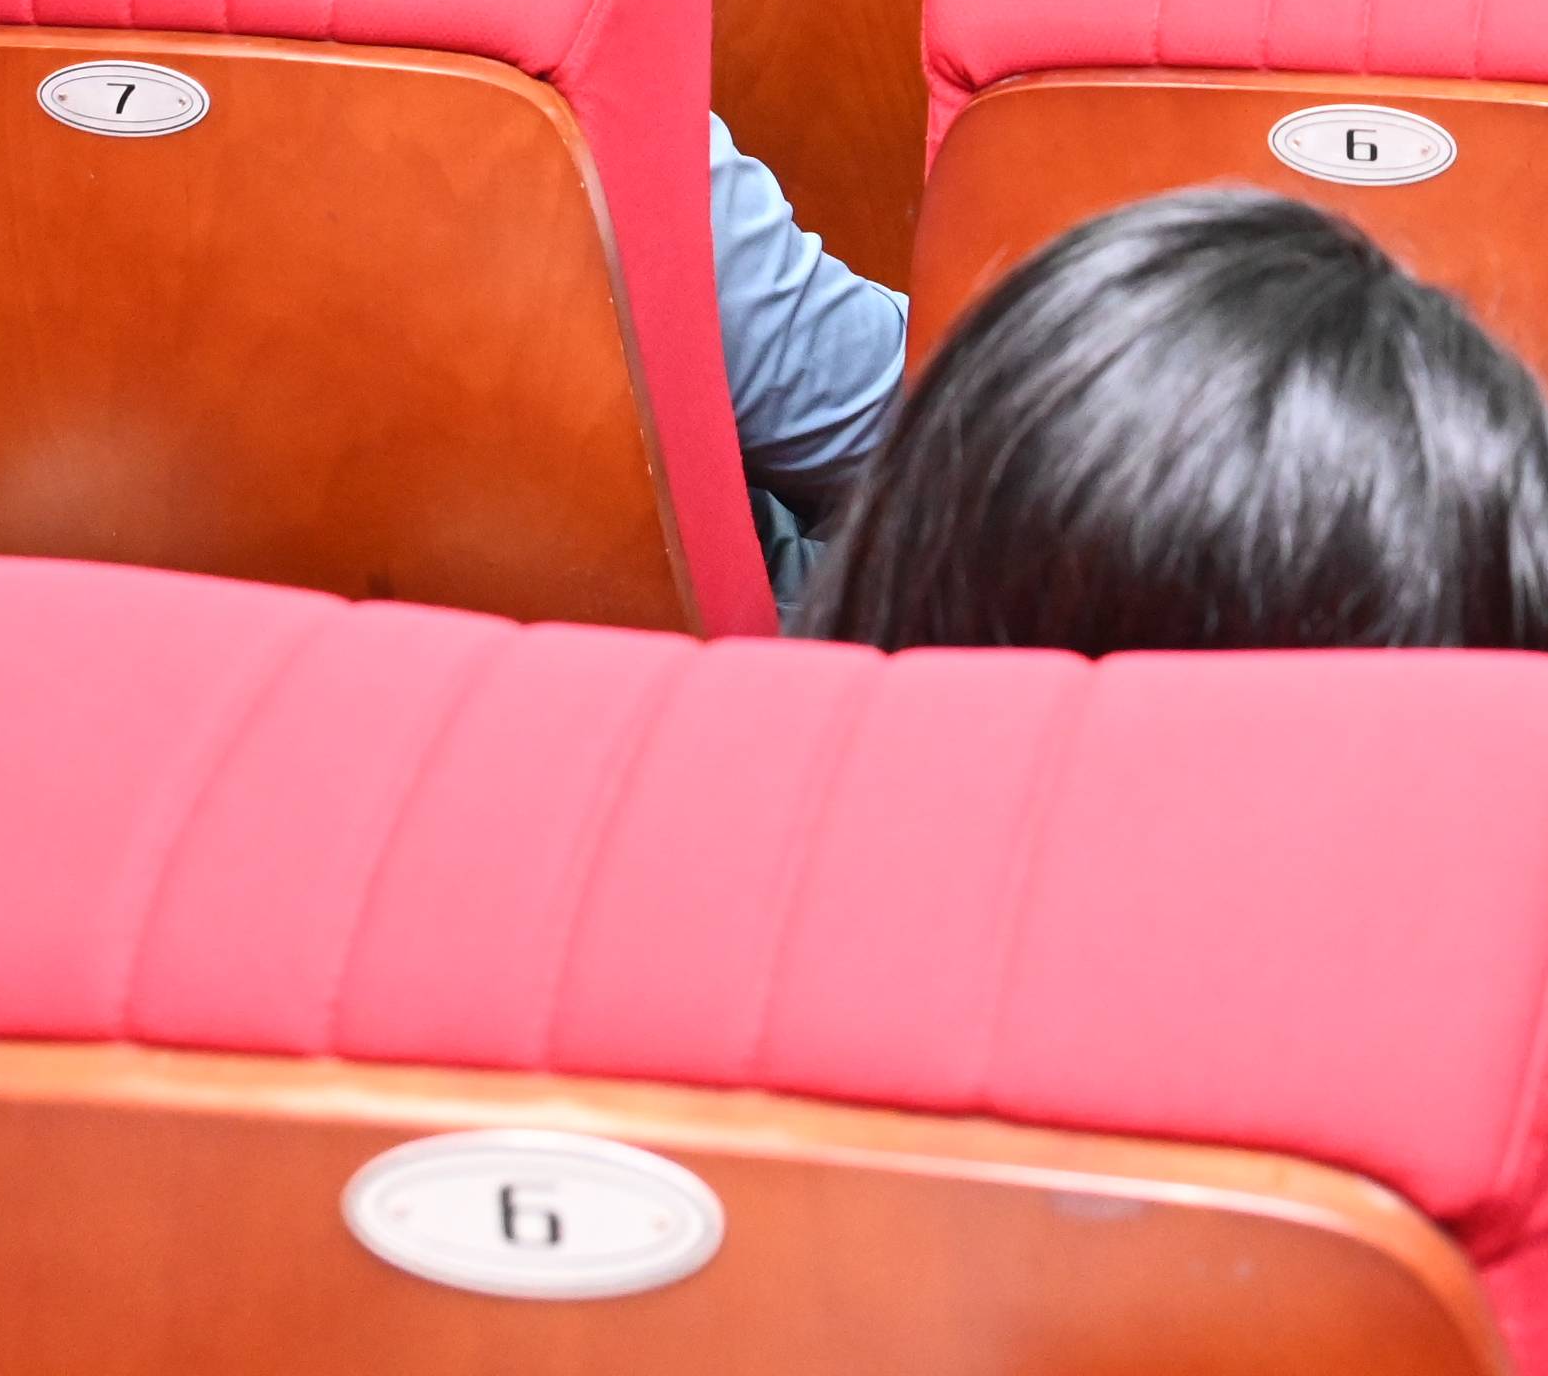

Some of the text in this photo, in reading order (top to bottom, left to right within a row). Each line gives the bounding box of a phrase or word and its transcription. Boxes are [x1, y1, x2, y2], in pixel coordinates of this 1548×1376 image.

[106, 82, 136, 115] 7
[1346, 128, 1378, 161] 6
[499, 1183, 562, 1247] 6
